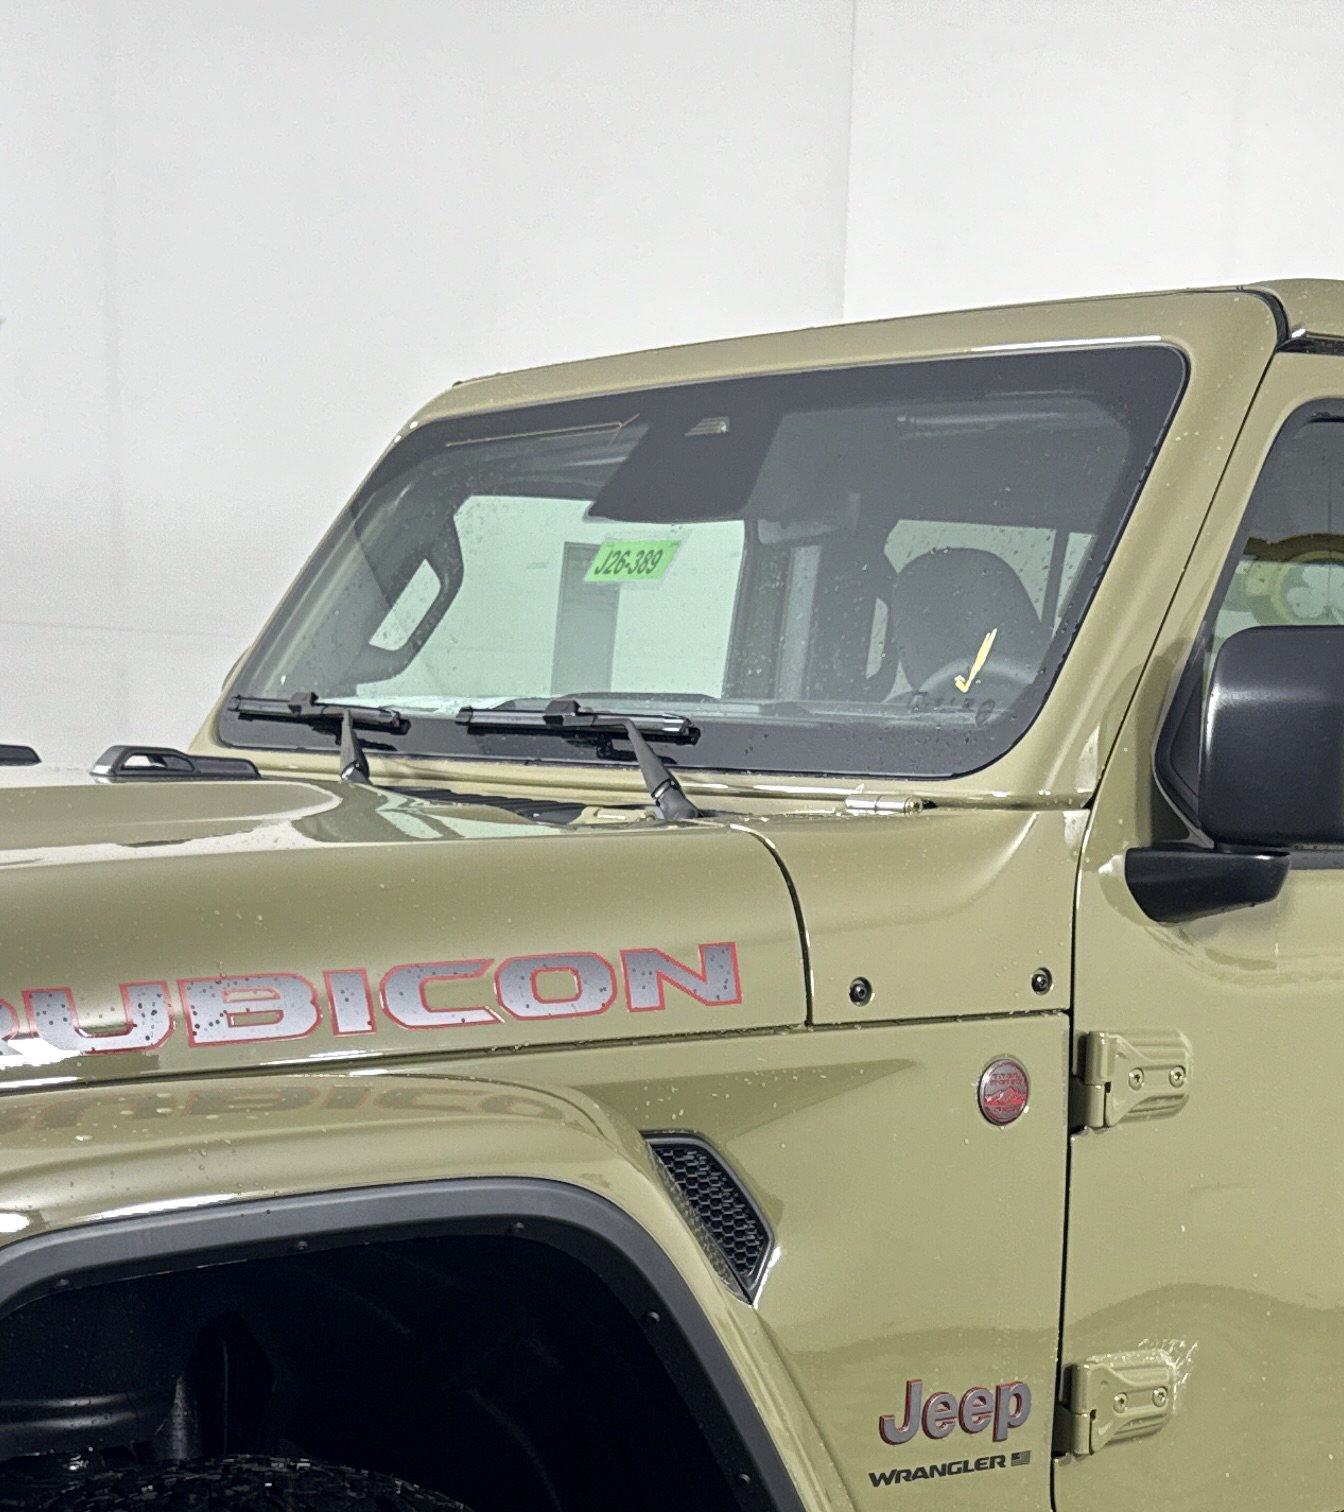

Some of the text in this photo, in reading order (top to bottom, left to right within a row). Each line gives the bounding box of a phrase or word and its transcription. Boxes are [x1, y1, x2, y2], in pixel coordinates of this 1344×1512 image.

[594, 549, 663, 575] J26-389
[879, 1378, 1032, 1445] Jeep
[868, 1454, 1006, 1488] WRANGLER
